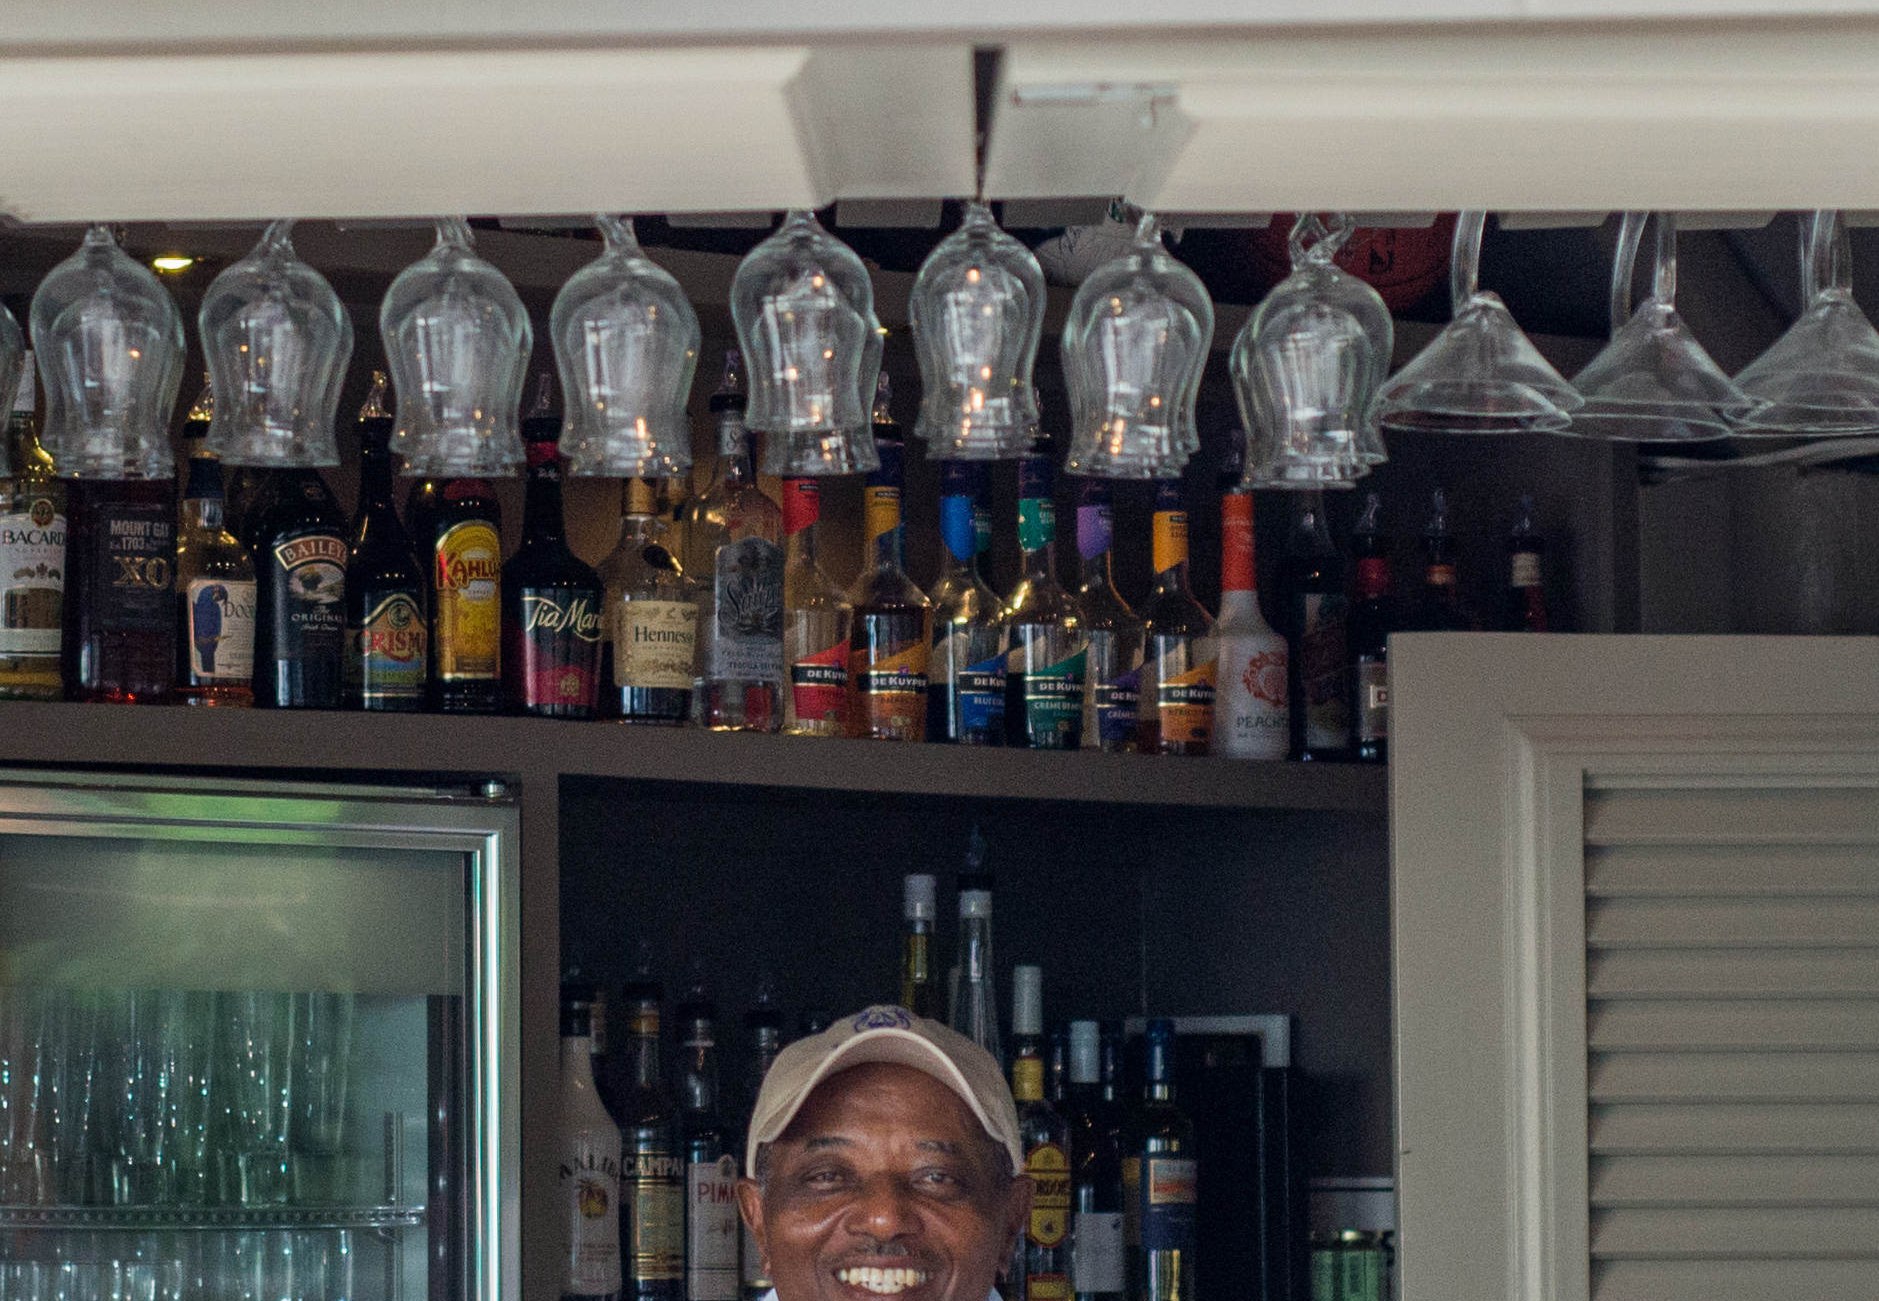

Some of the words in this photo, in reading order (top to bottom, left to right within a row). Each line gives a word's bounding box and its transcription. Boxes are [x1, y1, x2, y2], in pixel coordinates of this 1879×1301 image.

[109, 519, 151, 536] MOUNT
[152, 520, 171, 538] GAY
[120, 536, 146, 551] 1703
[111, 555, 171, 590] XO
[522, 596, 565, 632] Tia
[807, 669, 822, 679] DE
[870, 676, 887, 687] DE
[973, 677, 988, 687] DE
[1039, 682, 1055, 692] DE
[1111, 691, 1125, 701] DE
[1172, 689, 1187, 699] DE
